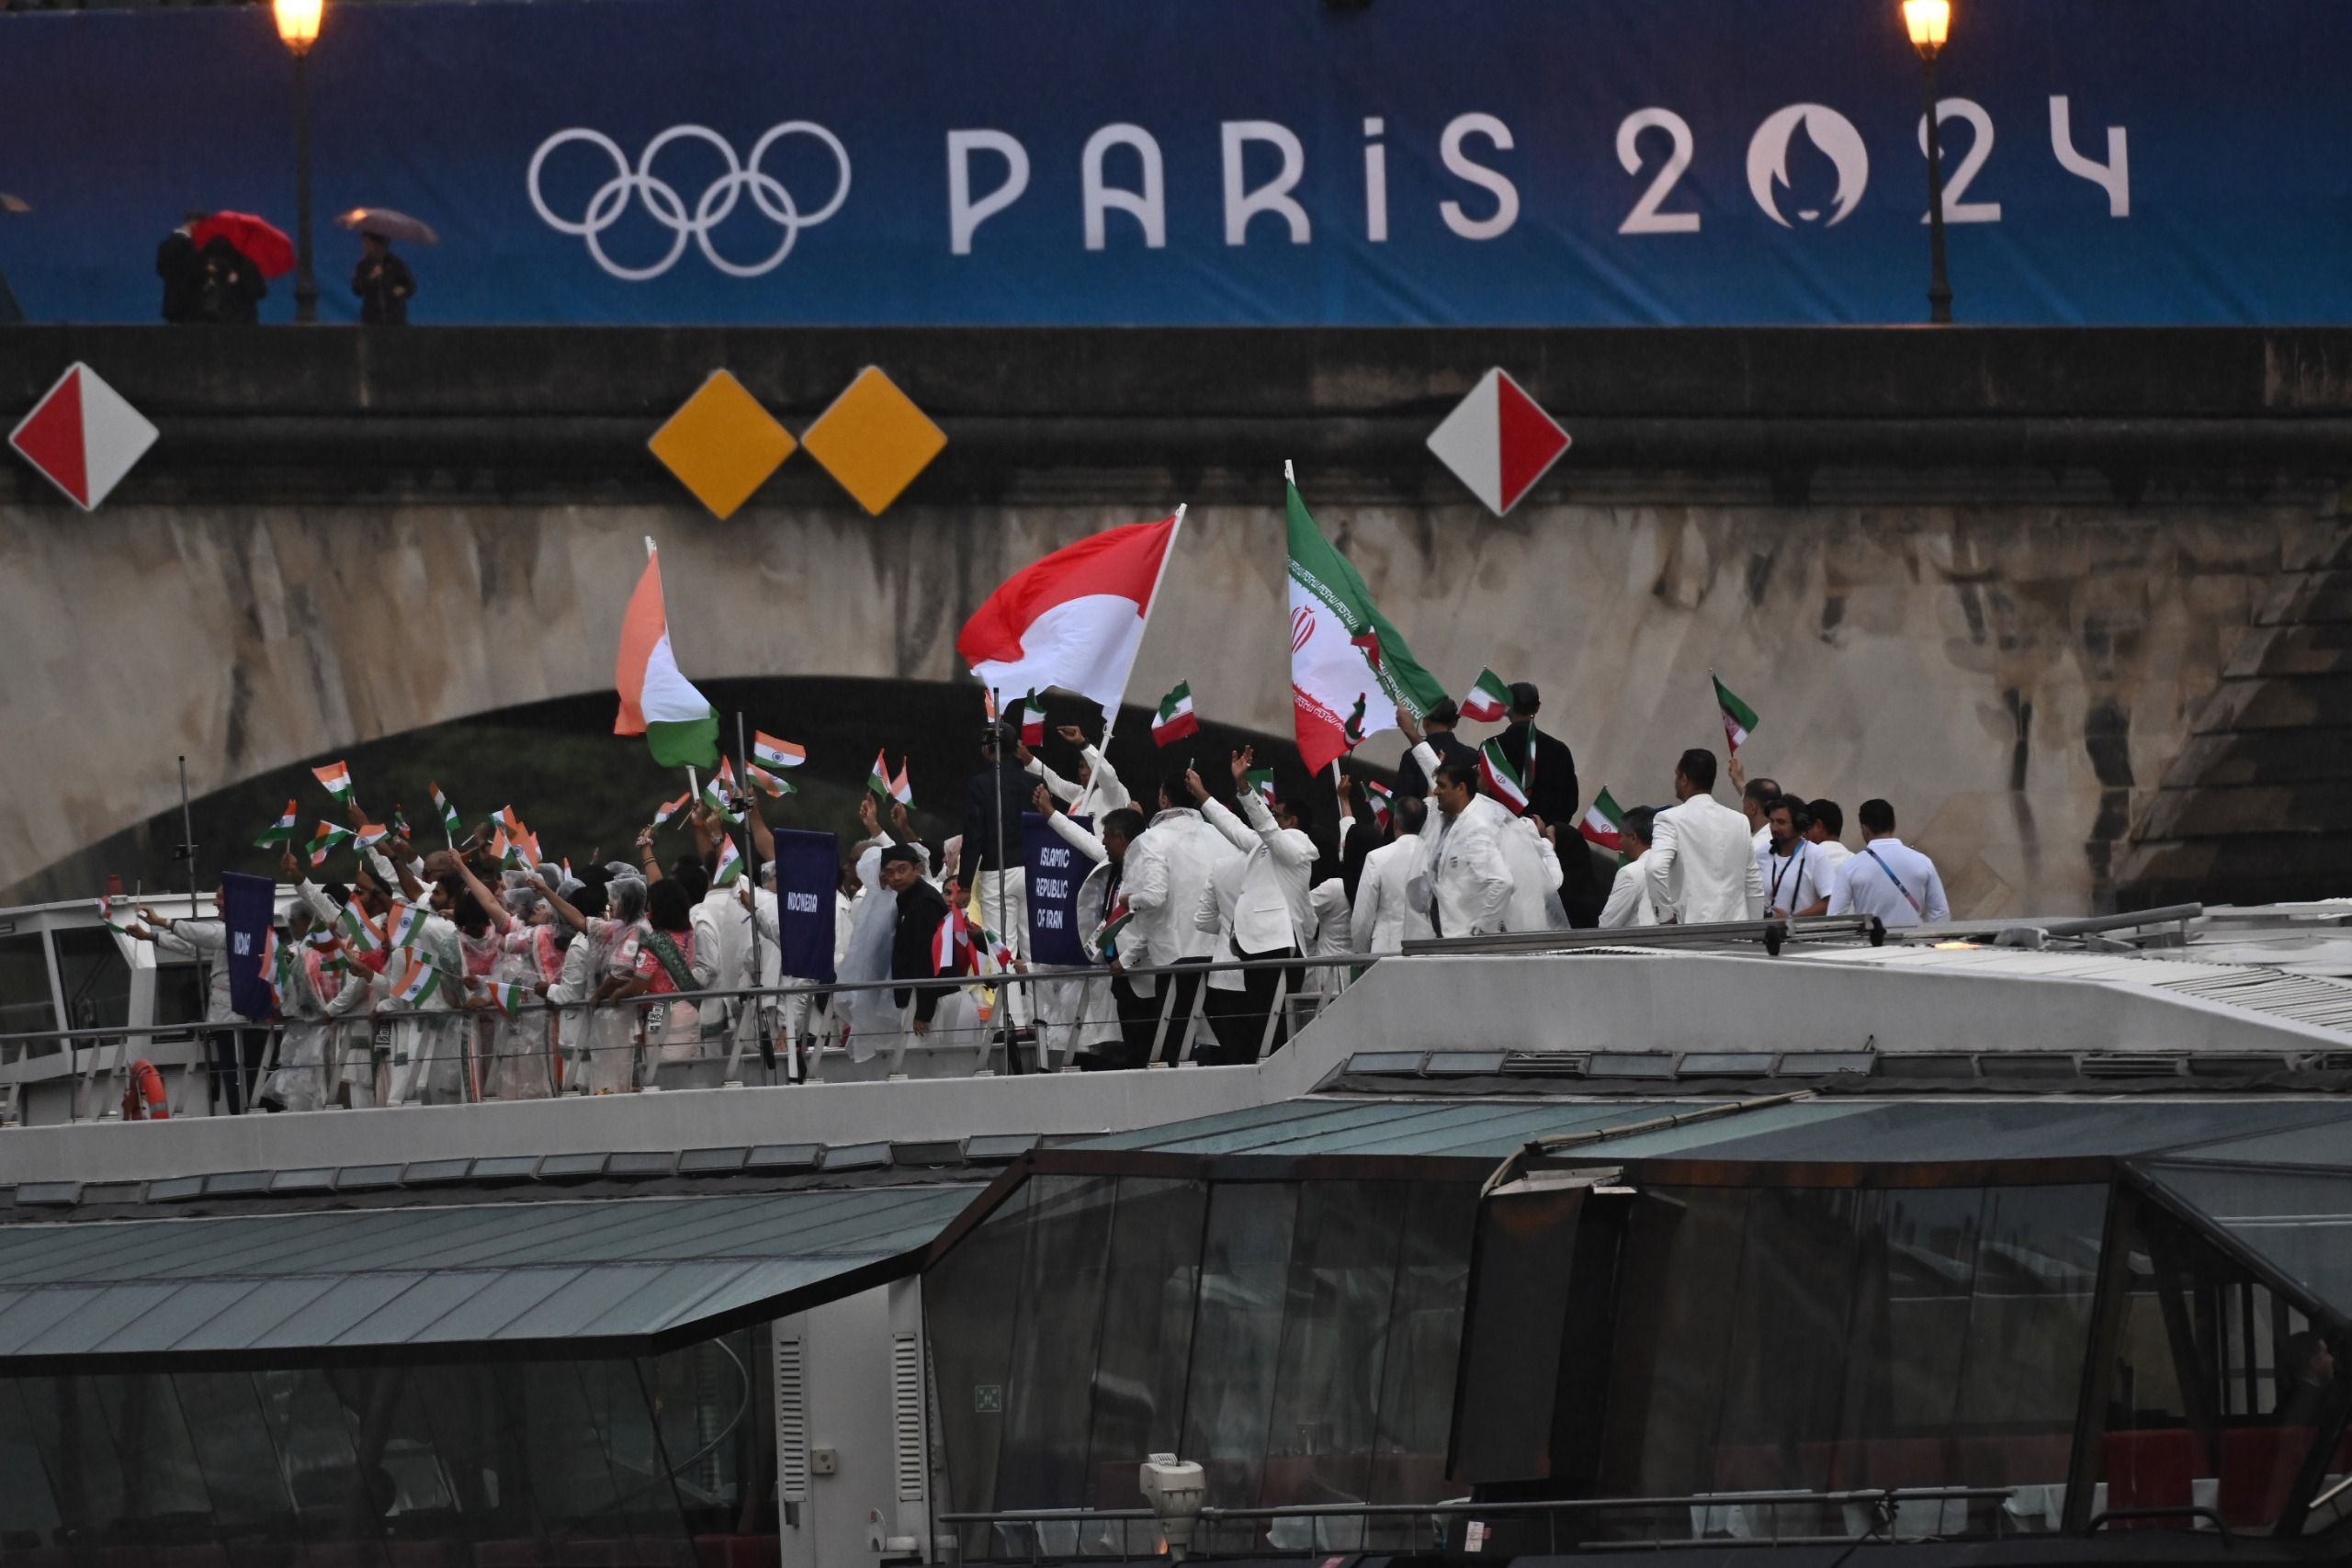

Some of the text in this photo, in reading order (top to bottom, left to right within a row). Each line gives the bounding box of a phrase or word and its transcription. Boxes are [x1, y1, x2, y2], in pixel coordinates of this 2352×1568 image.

[1040, 847, 1070, 868] ISLAMIC
[1035, 876, 1069, 899] REPUBLIC
[786, 891, 819, 913] INDONESIA
[1036, 908, 1064, 931] OF IRAN
